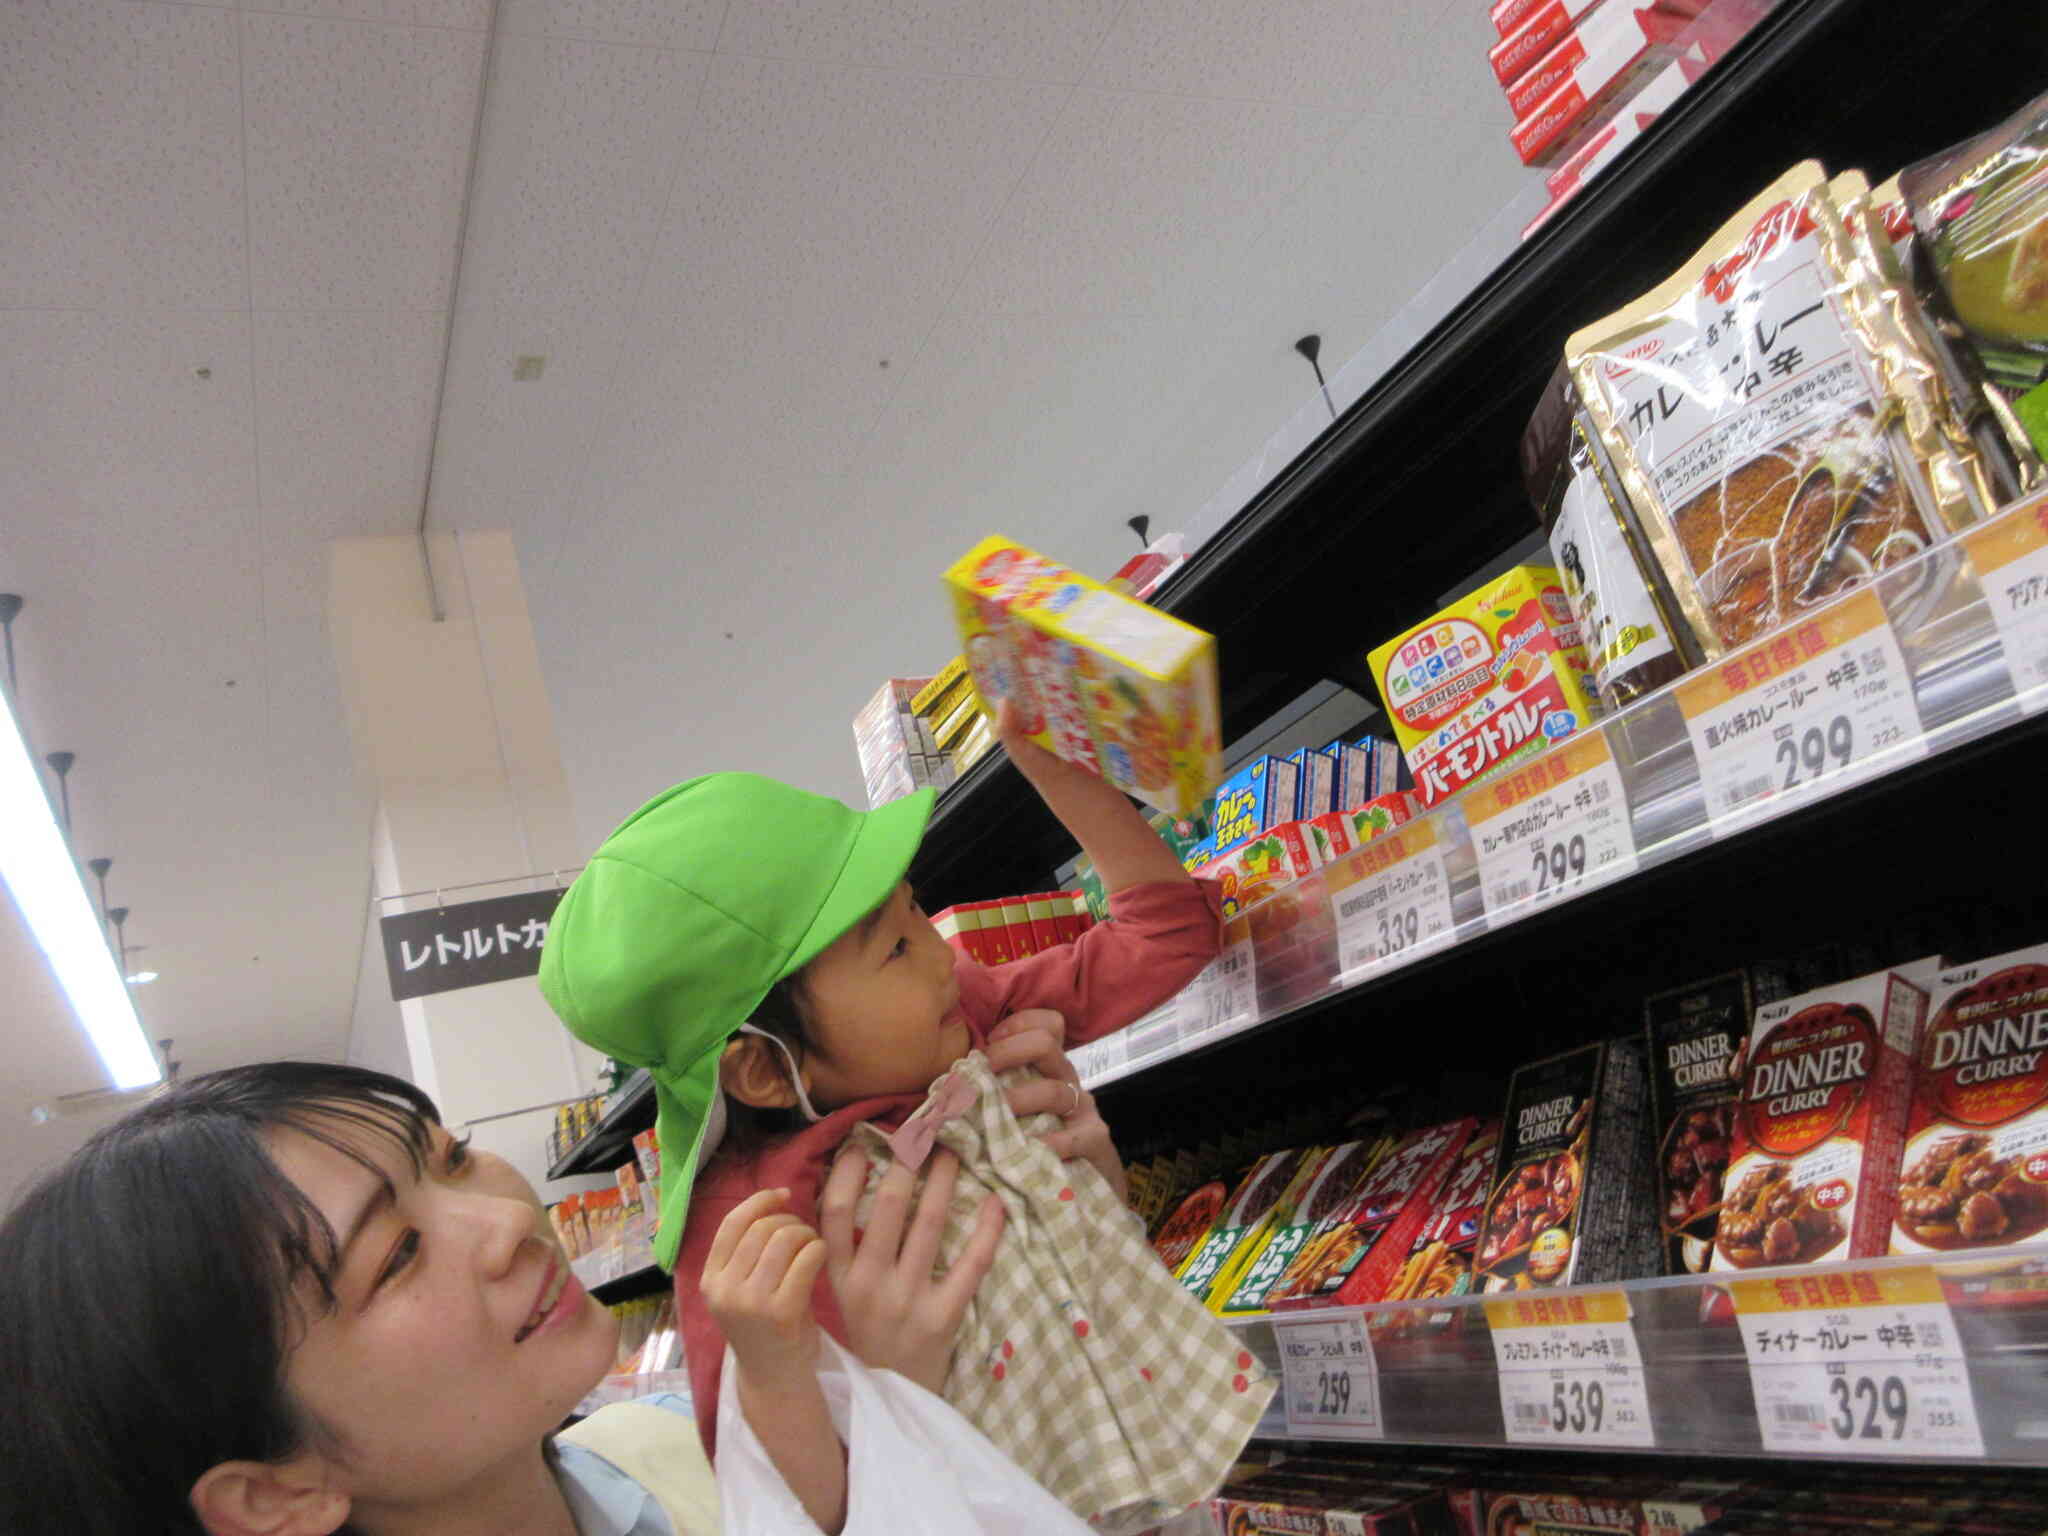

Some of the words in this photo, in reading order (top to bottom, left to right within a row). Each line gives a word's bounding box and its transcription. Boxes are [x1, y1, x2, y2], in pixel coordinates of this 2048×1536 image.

[1826, 660, 1860, 691] 中辛
[1420, 695, 1552, 806] バーモントカレー
[1776, 714, 1854, 791] 299
[1532, 833, 1587, 901] 299
[1377, 906, 1419, 960] 339
[1668, 1032, 1732, 1069] DINNER
[1956, 1050, 2044, 1085] CURRY
[1674, 1056, 1728, 1087] CURRY
[1751, 1040, 1867, 1100] DINNER
[1518, 1096, 1574, 1129] DINNER
[1768, 1086, 1836, 1117] CURRY
[1519, 1117, 1566, 1145] CURRY
[1816, 1185, 1846, 1204] 中辛
[1755, 1325, 1868, 1353] ディナーカレー
[1876, 1323, 1916, 1349] 中辛
[1318, 1371, 1351, 1416] 259
[1552, 1380, 1604, 1433] 539
[1829, 1375, 1909, 1440] 329
